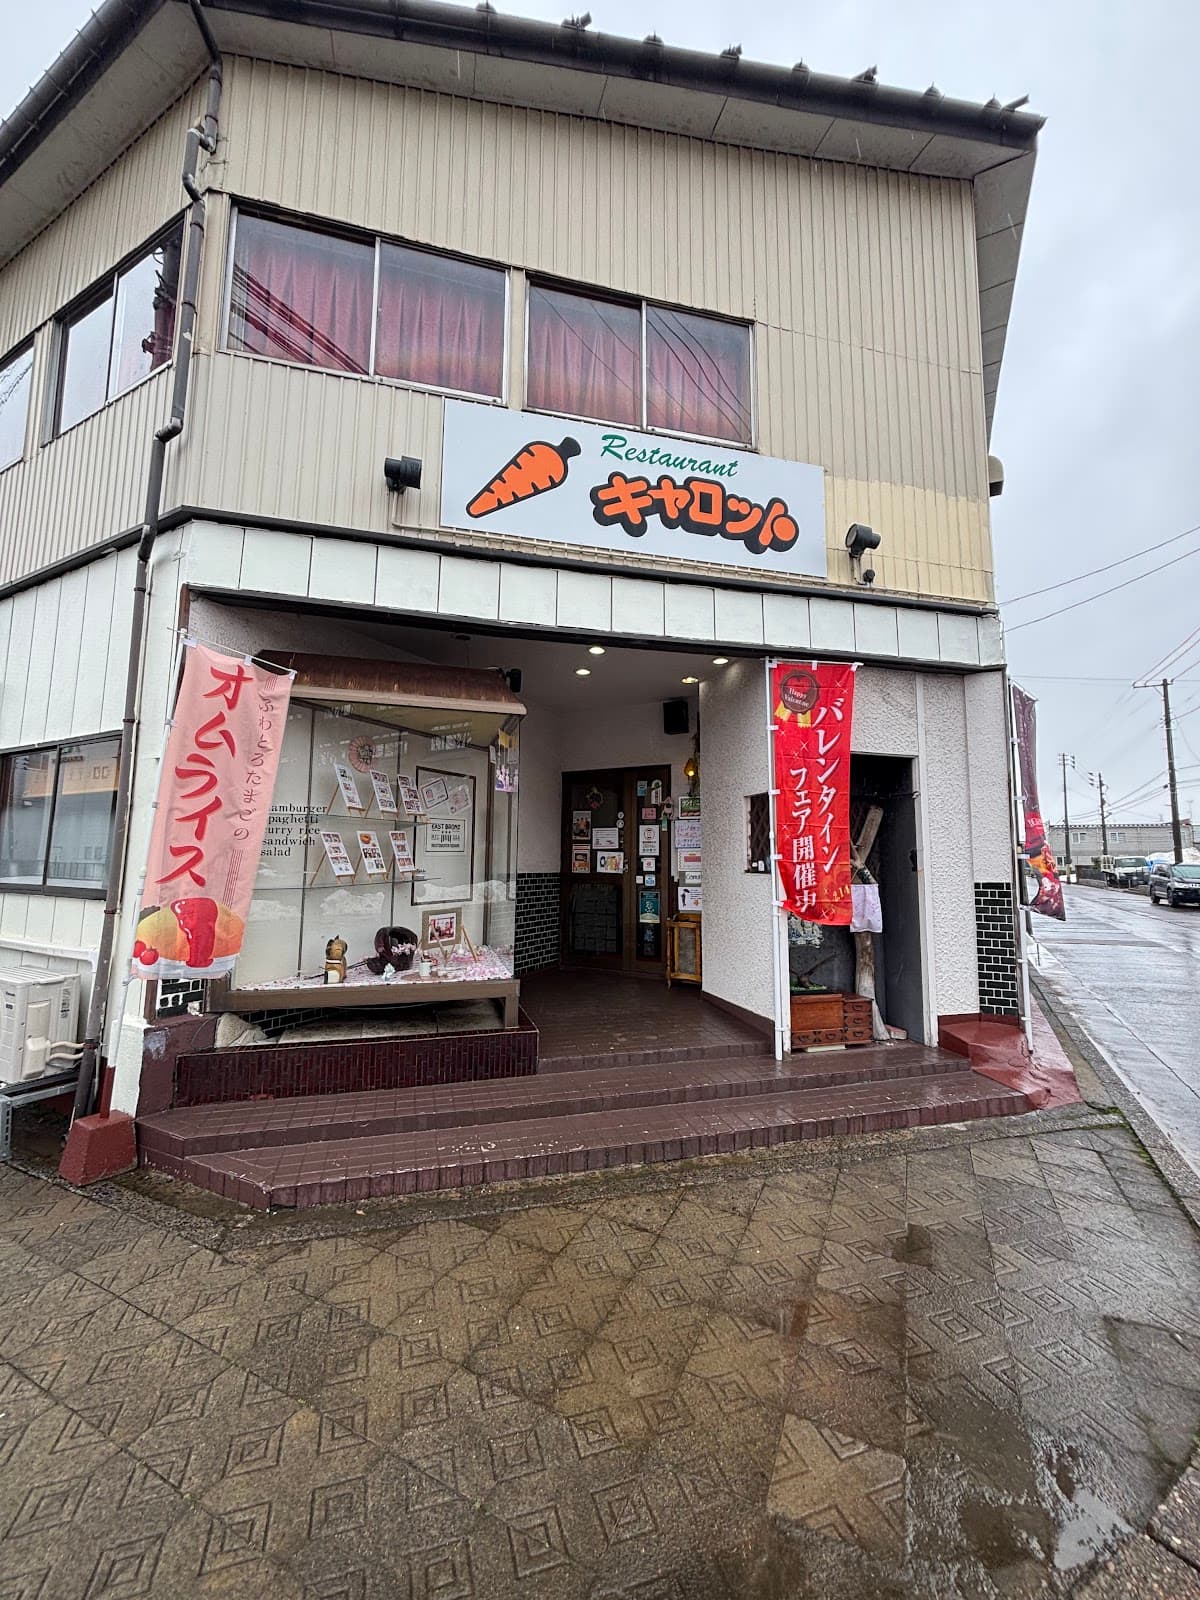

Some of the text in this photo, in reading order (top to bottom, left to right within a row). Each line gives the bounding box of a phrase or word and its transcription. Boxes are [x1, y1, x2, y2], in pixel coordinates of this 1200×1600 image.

[601, 434, 739, 477] Restaurant
[591, 472, 799, 553] キャロット
[155, 664, 254, 888] オムライス
[233, 694, 276, 842] ふわとろたまごの
[812, 697, 845, 874] バレンタイン
[267, 814, 320, 825] paghetti
[270, 803, 328, 814] amburger
[260, 847, 291, 857] salad
[262, 837, 316, 846] sandwich
[789, 767, 818, 913] フェア開催中
